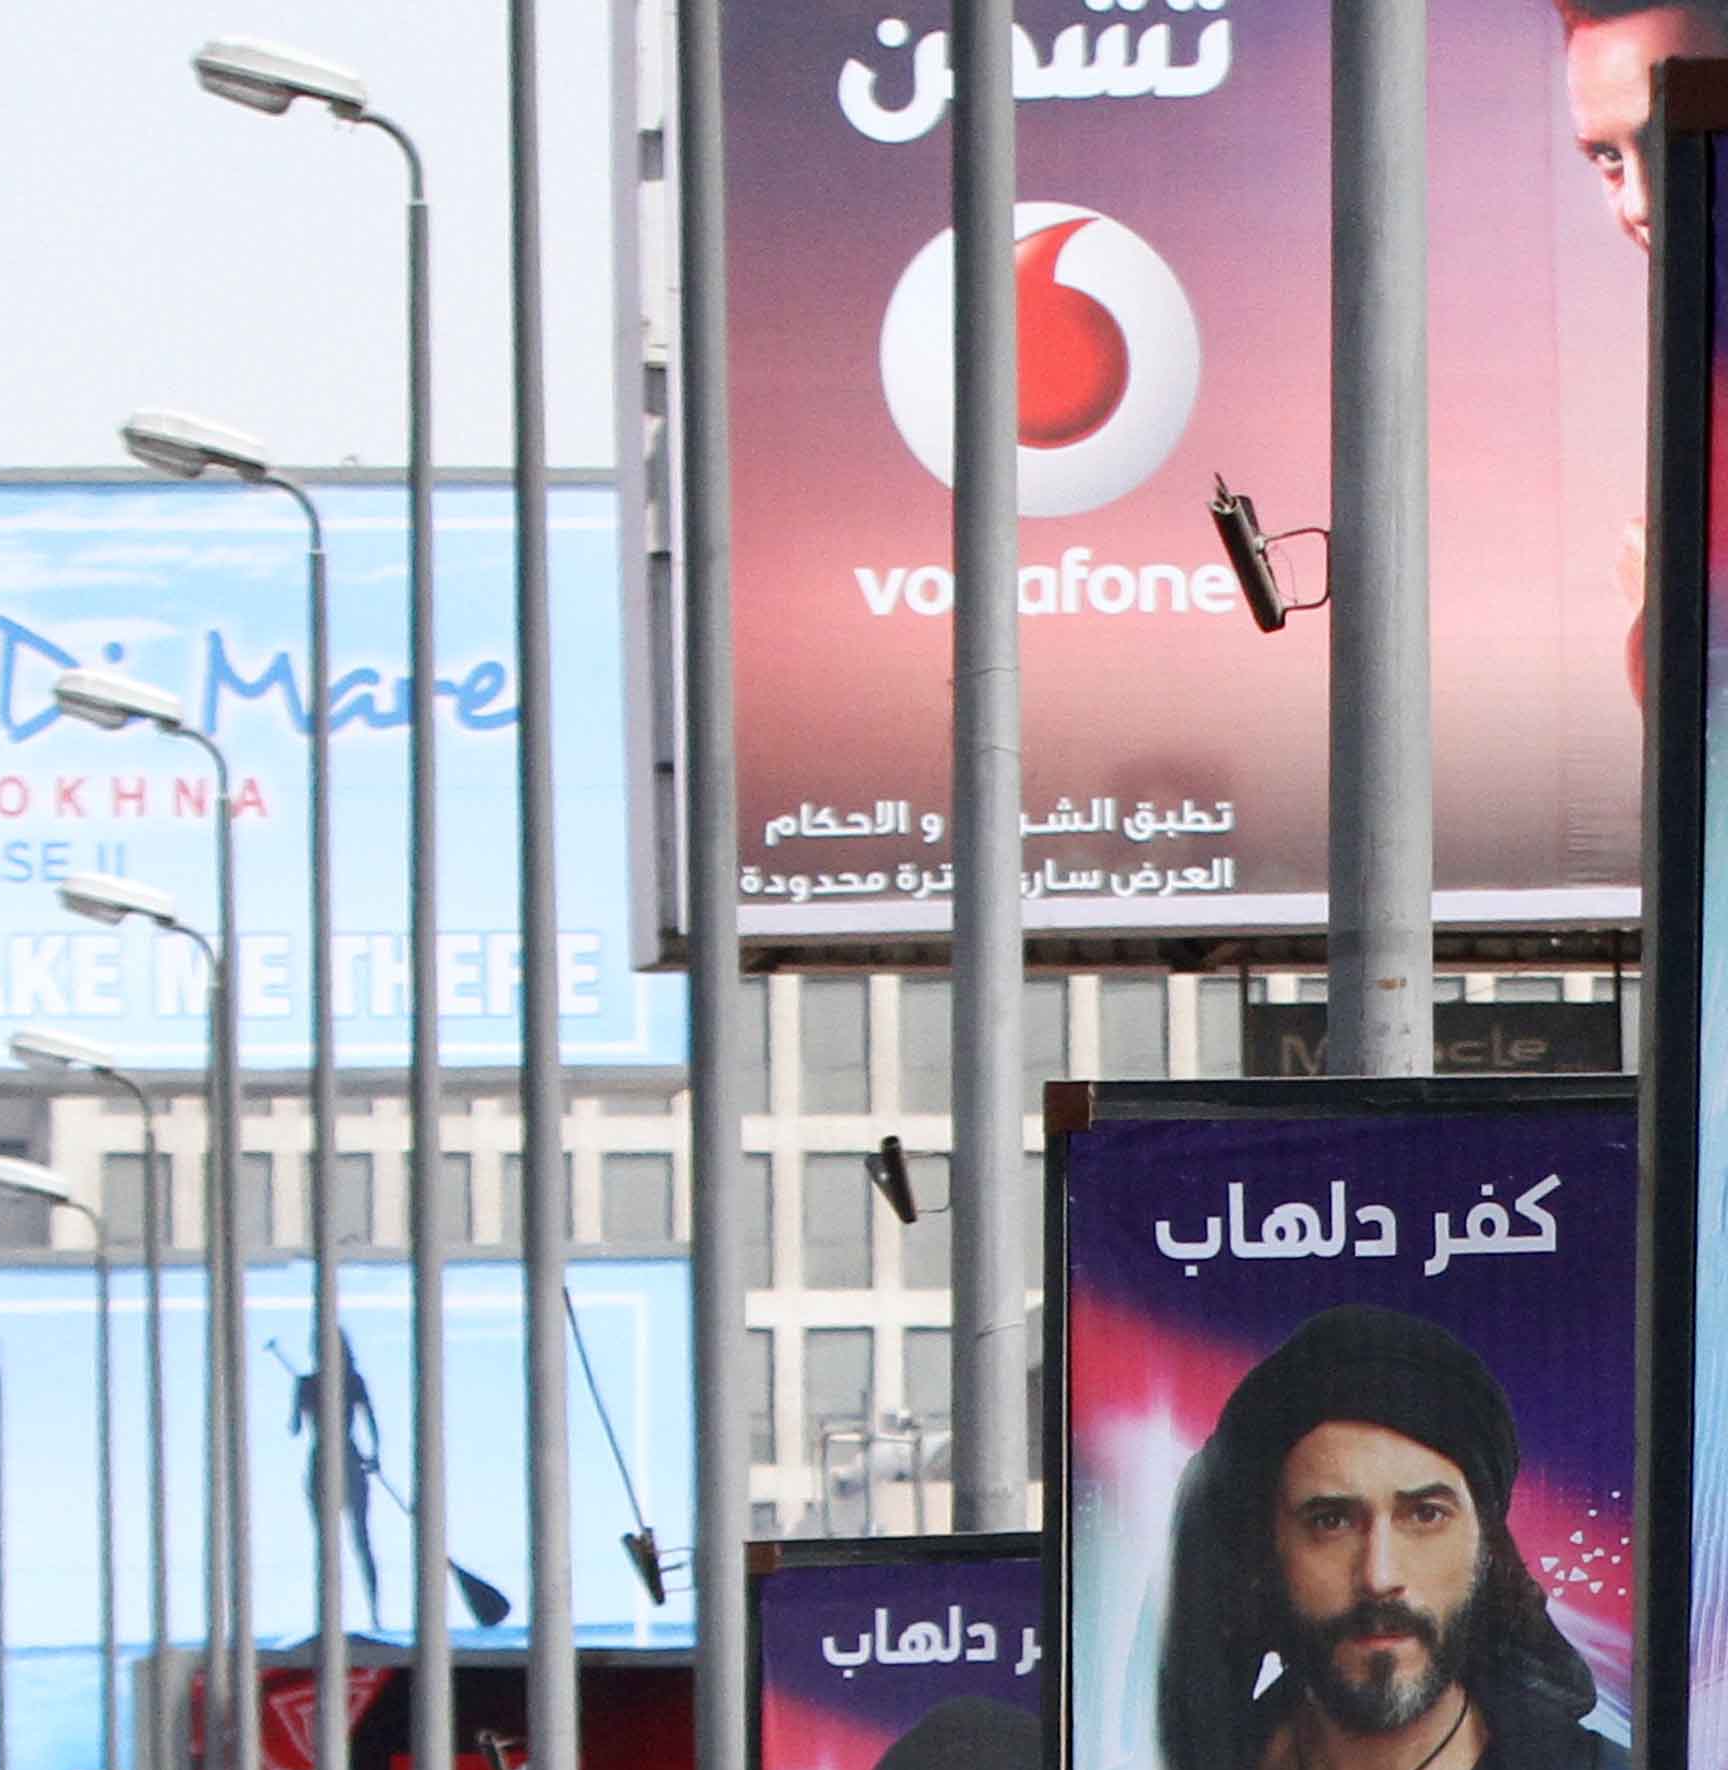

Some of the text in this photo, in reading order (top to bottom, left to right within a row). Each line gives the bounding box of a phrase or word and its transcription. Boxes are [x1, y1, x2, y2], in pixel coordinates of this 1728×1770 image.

[854, 547, 1236, 616] voafone
[204, 630, 521, 737] Mare
[765, 800, 910, 846] الاحكام
[920, 812, 944, 842] و
[1123, 799, 1234, 842] تطبق
[740, 865, 889, 902] محدودة
[1111, 857, 1235, 896] العرض
[1155, 1173, 1562, 1277] كفر دلهاب
[822, 1605, 998, 1678] دلهاب
